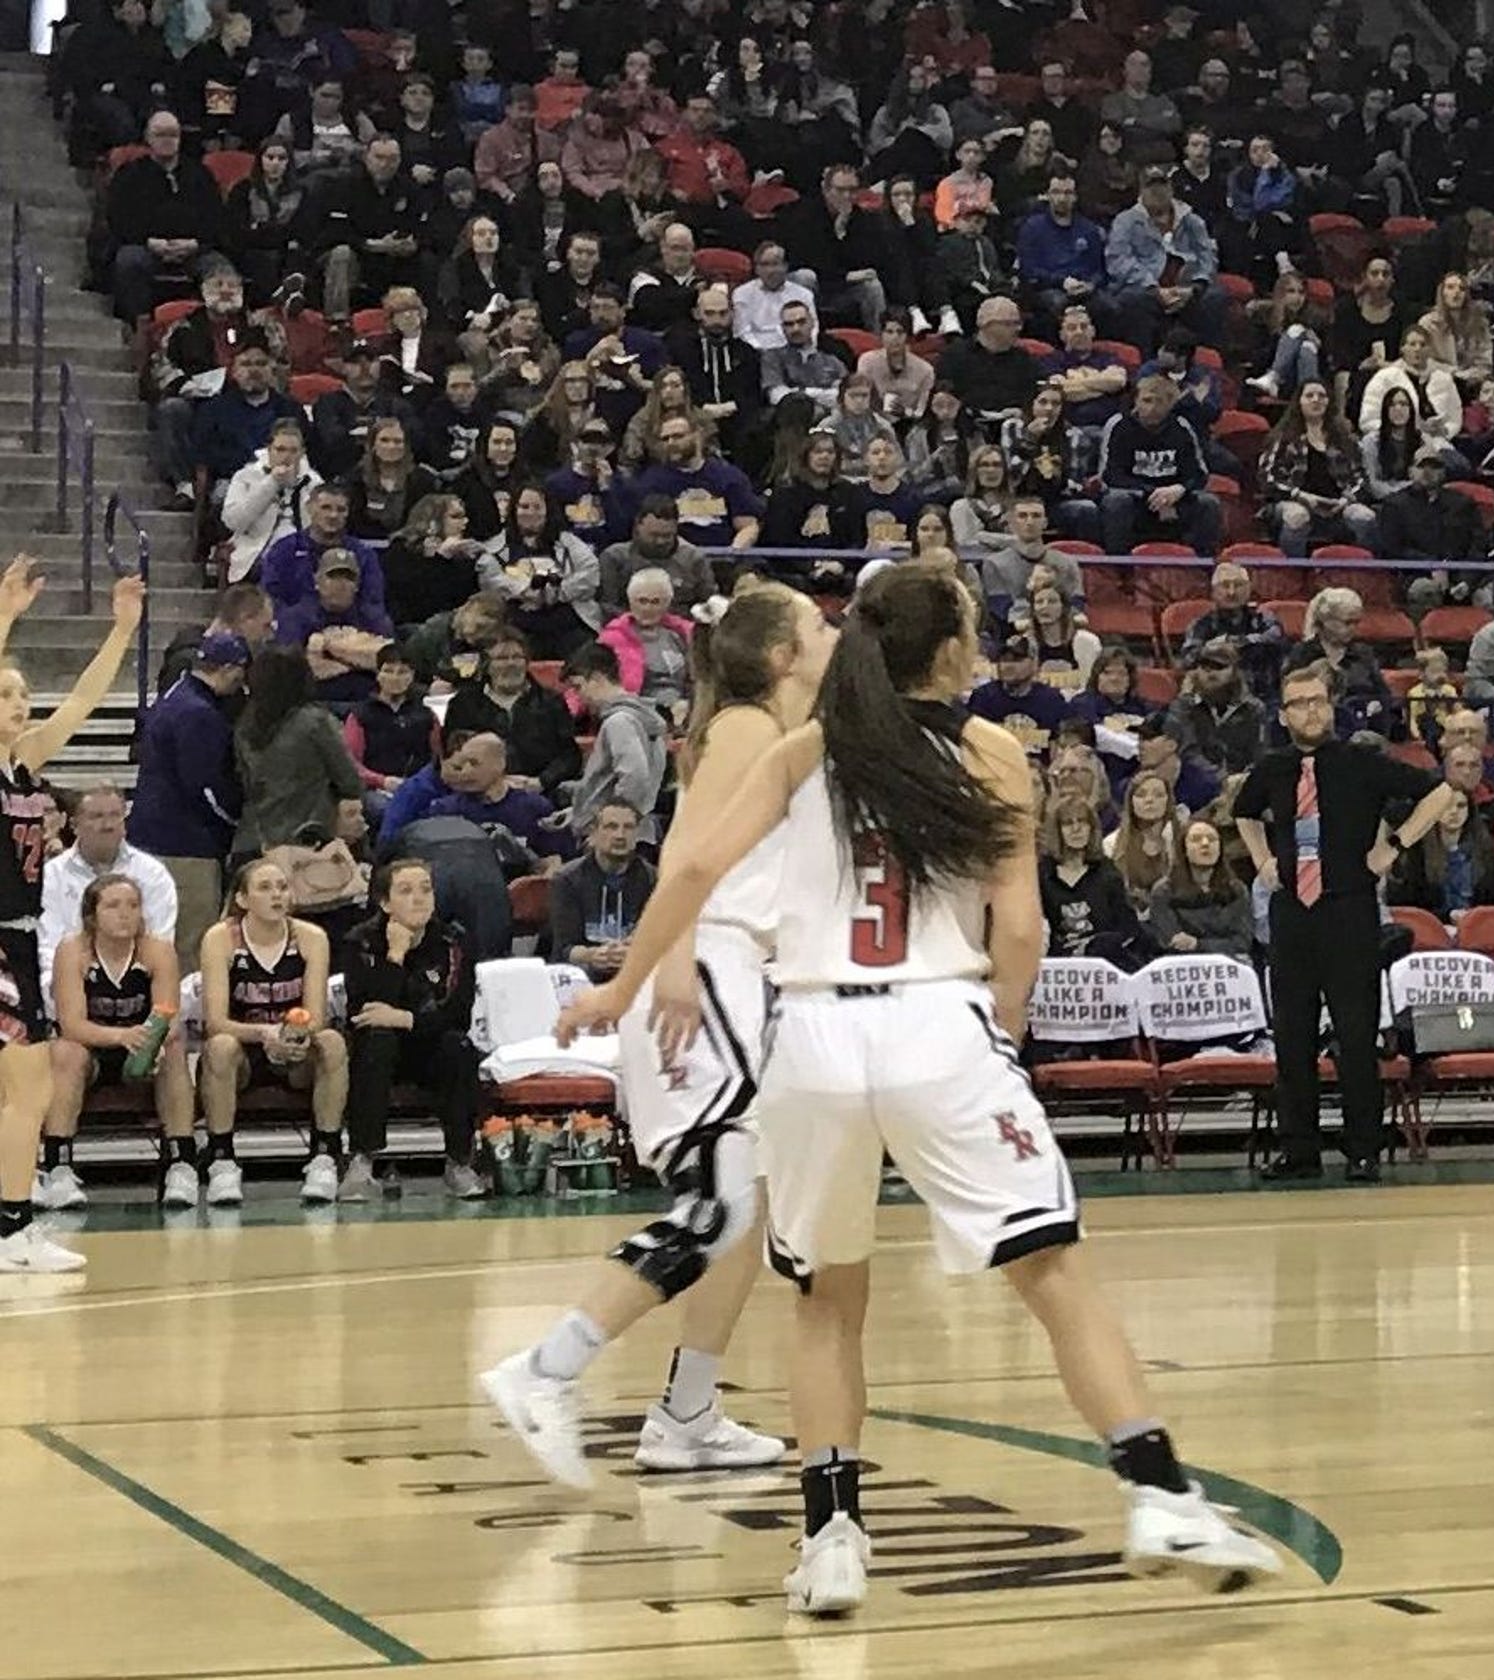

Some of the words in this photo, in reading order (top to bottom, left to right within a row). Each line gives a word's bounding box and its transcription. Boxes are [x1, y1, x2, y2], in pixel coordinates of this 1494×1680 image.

[851, 828, 910, 967] 3
[1037, 969, 1119, 985] ECOVER
[1152, 965, 1239, 983] RECOVER
[1424, 974, 1464, 989] LIKE
[1471, 975, 1482, 989] A
[1044, 987, 1081, 1002] LIKE
[1093, 988, 1104, 1002] A
[1168, 985, 1207, 999] LIKE
[1215, 983, 1227, 996] A
[1152, 998, 1251, 1018] CHAMPION
